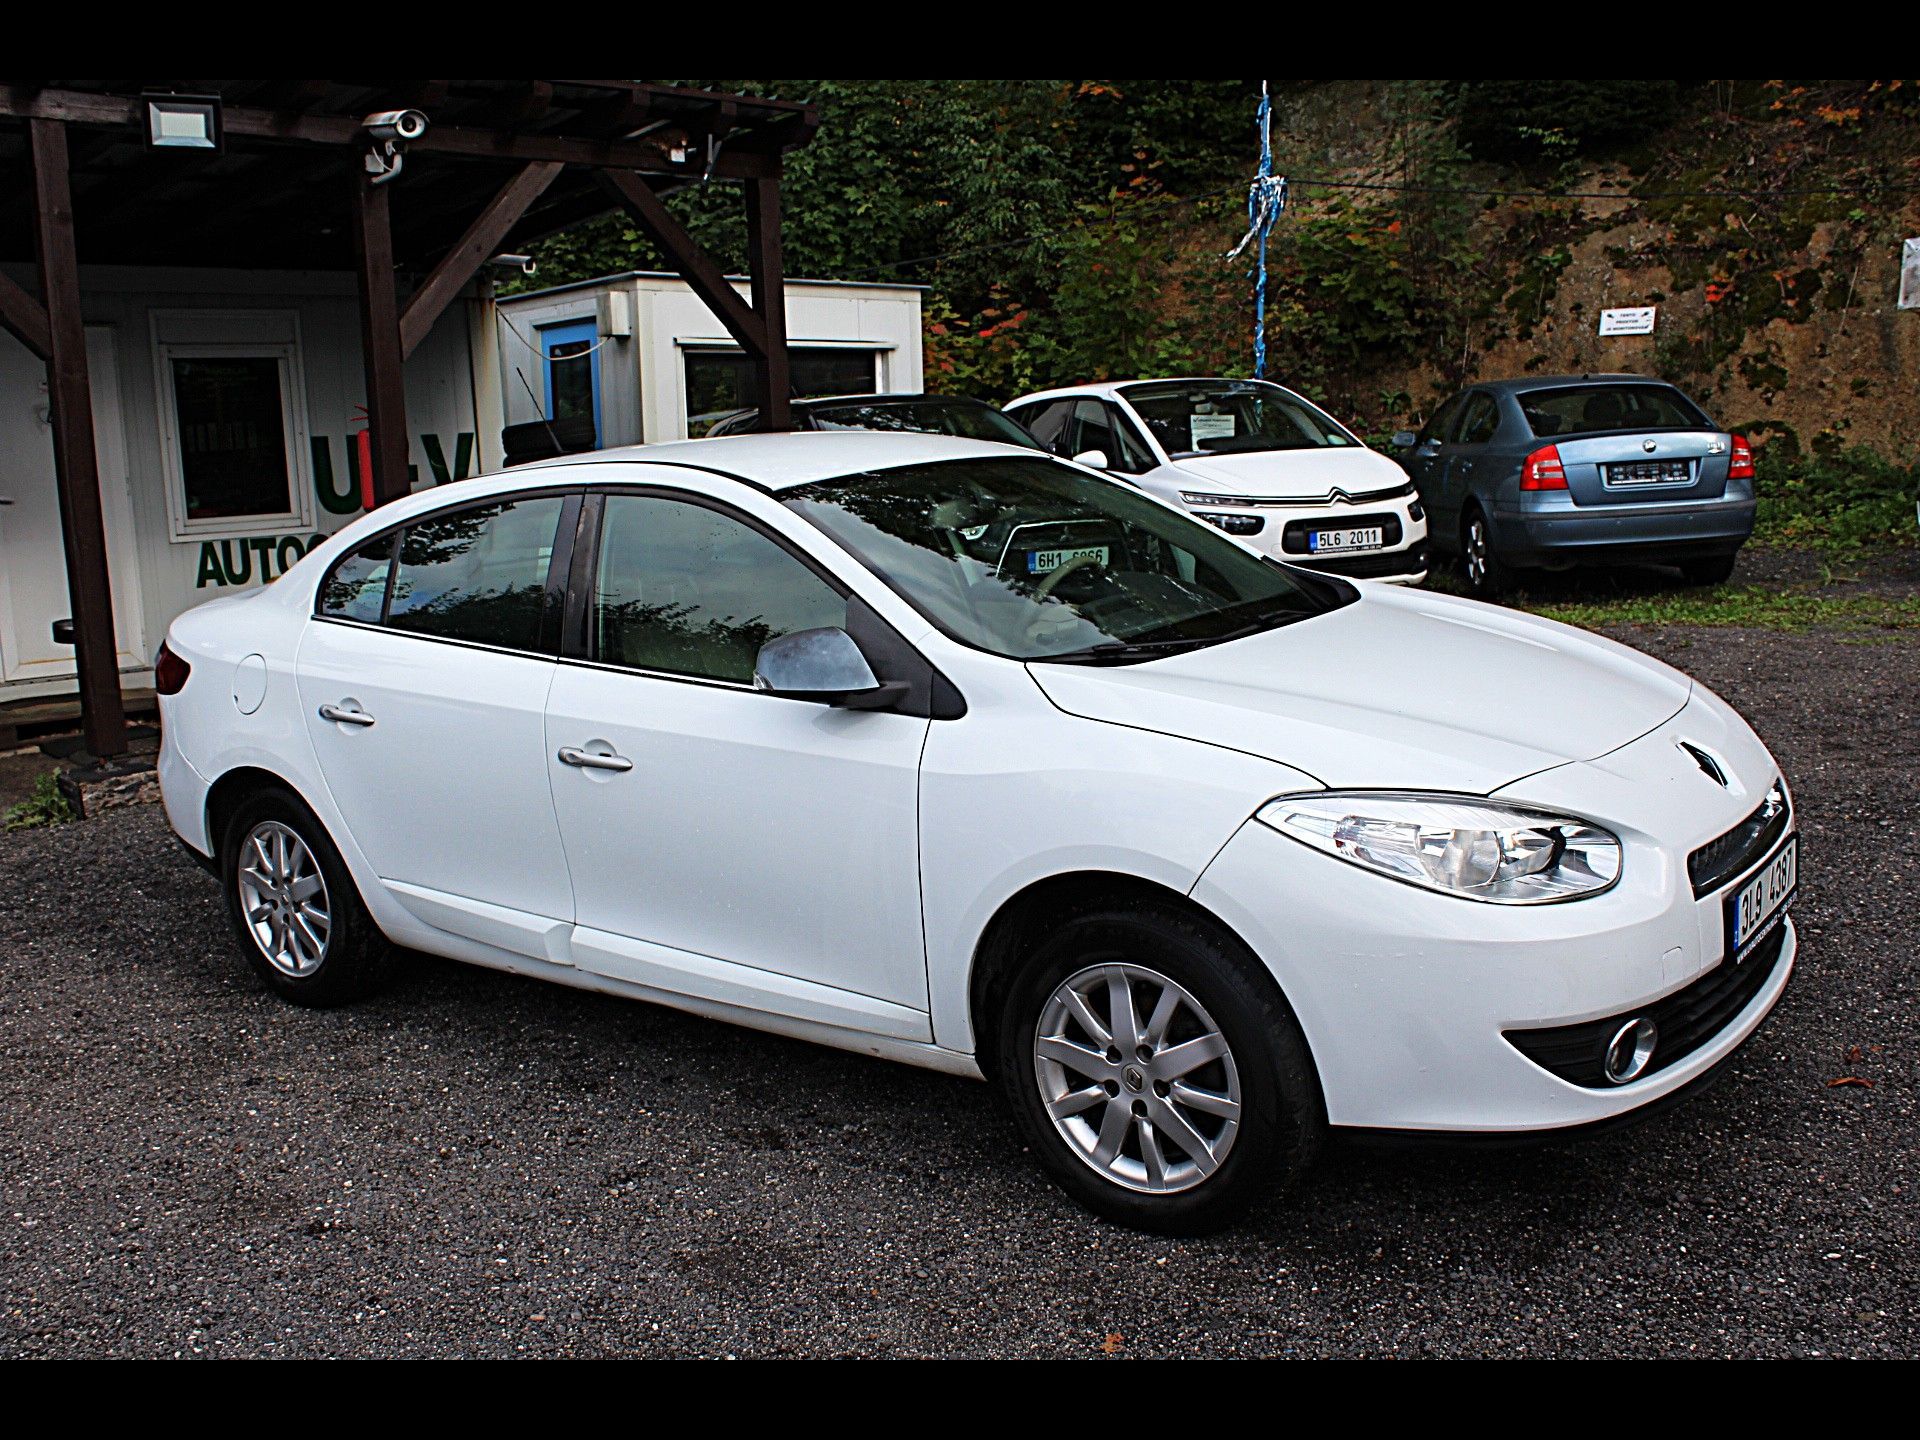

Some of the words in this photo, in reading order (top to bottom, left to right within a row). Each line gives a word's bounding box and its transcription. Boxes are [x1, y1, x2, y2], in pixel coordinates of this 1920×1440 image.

[1319, 532, 1341, 547] 5L6
[1350, 529, 1377, 545] 2011
[1038, 552, 1062, 568] 6H1
[1741, 880, 1763, 936] 3L9
[1769, 845, 1792, 904] 4387
